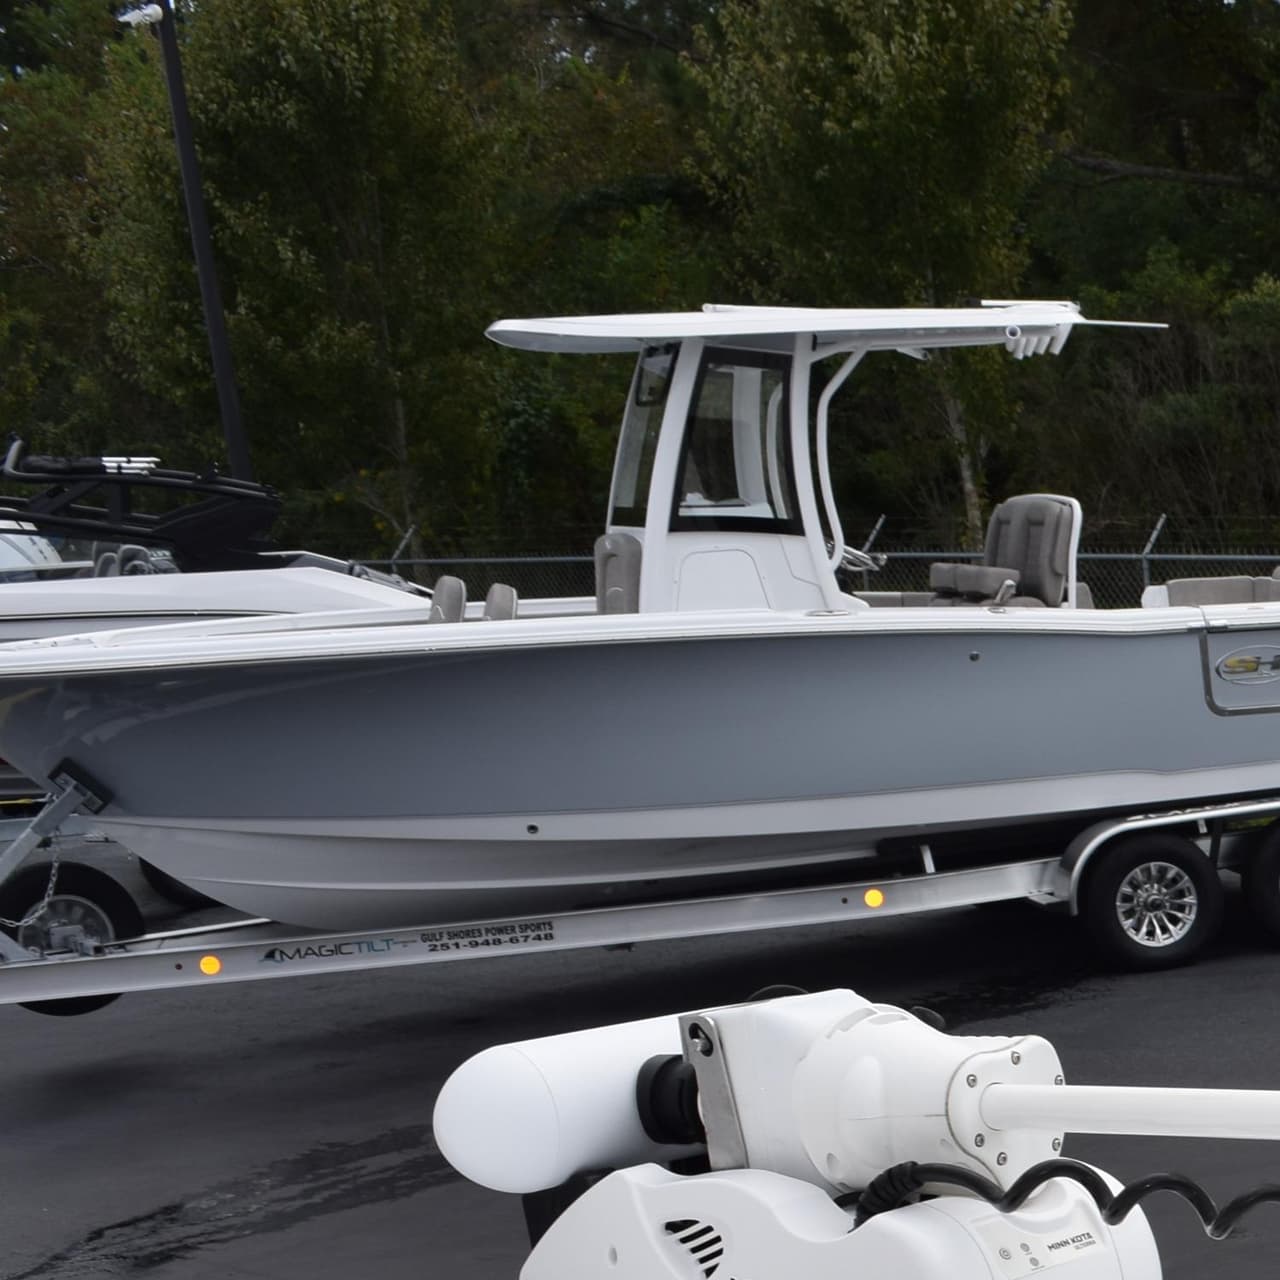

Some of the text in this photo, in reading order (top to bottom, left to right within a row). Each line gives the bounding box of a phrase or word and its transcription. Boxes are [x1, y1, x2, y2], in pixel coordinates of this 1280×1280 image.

[420, 931, 444, 943] GULF
[446, 928, 482, 941] SHORES
[484, 925, 517, 937] POWER
[518, 921, 554, 934] SPORTS
[427, 932, 554, 953] 251-948-6748
[1047, 1232, 1092, 1250] MINN KOTA
